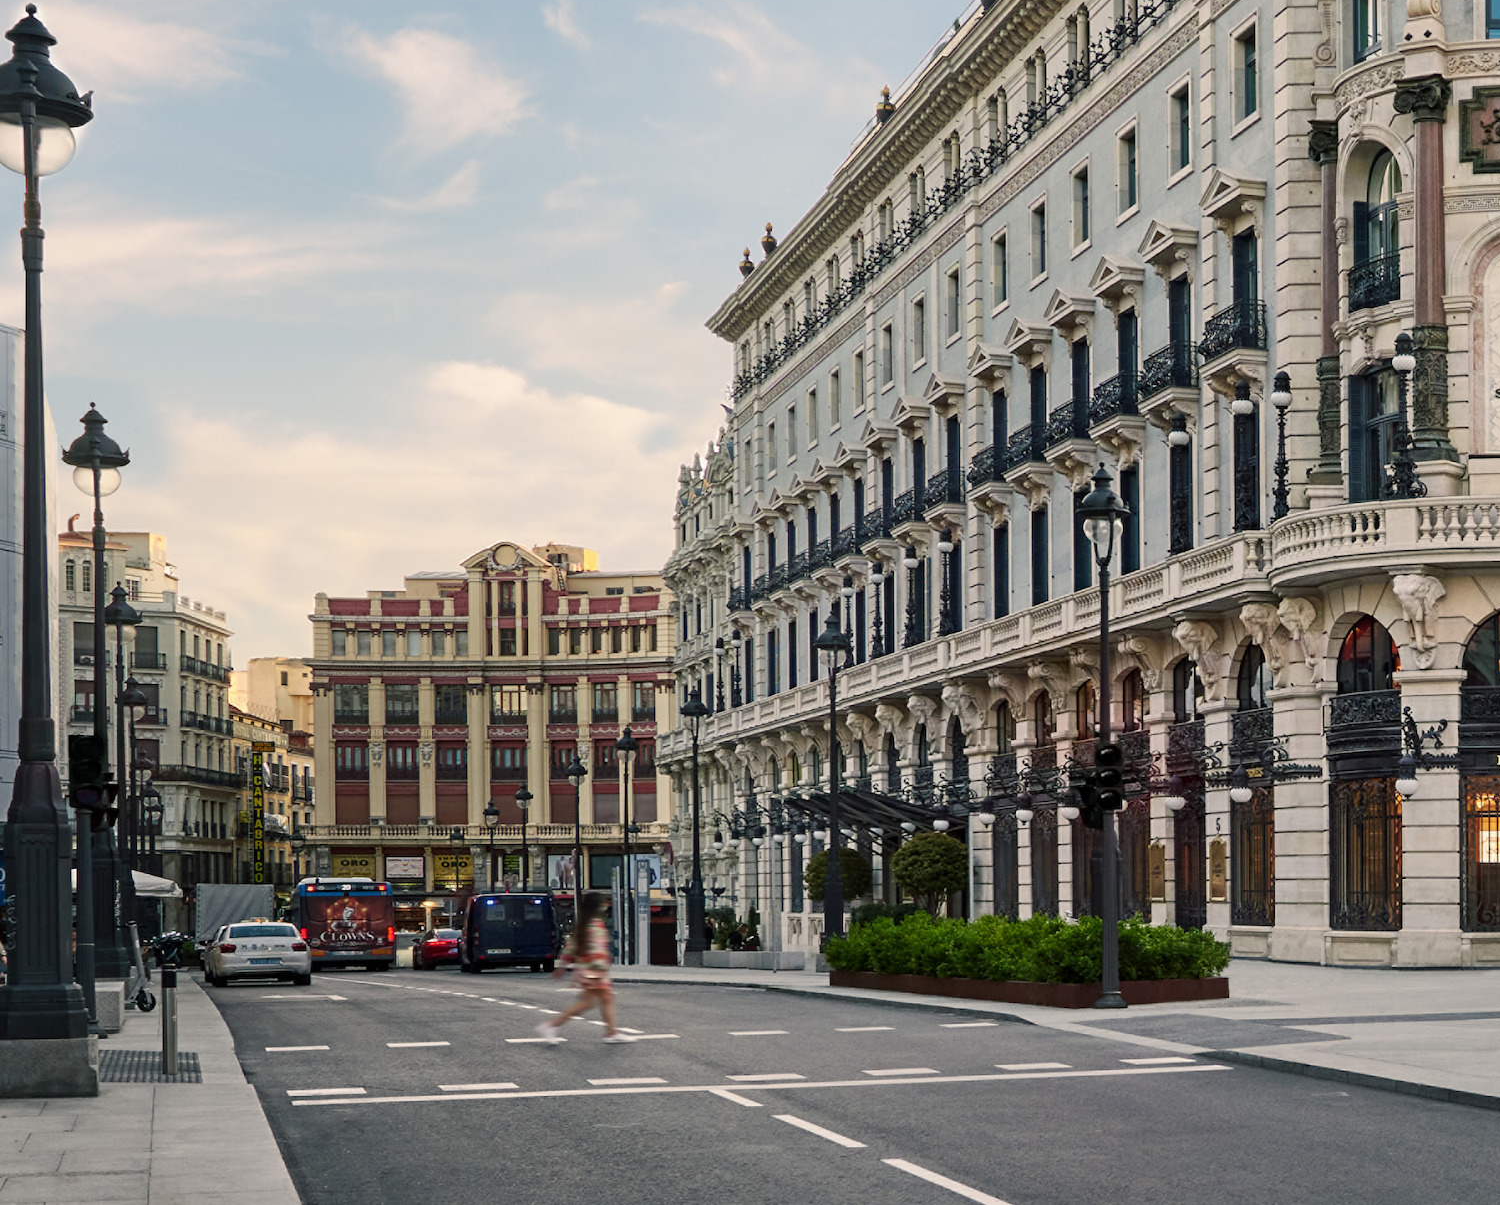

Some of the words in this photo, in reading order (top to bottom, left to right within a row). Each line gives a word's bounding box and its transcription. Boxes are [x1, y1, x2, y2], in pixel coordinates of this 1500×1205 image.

[253, 776, 263, 883] CANTABRICO
[1215, 817, 1221, 832] 5
[320, 930, 375, 942] CLOWNS
